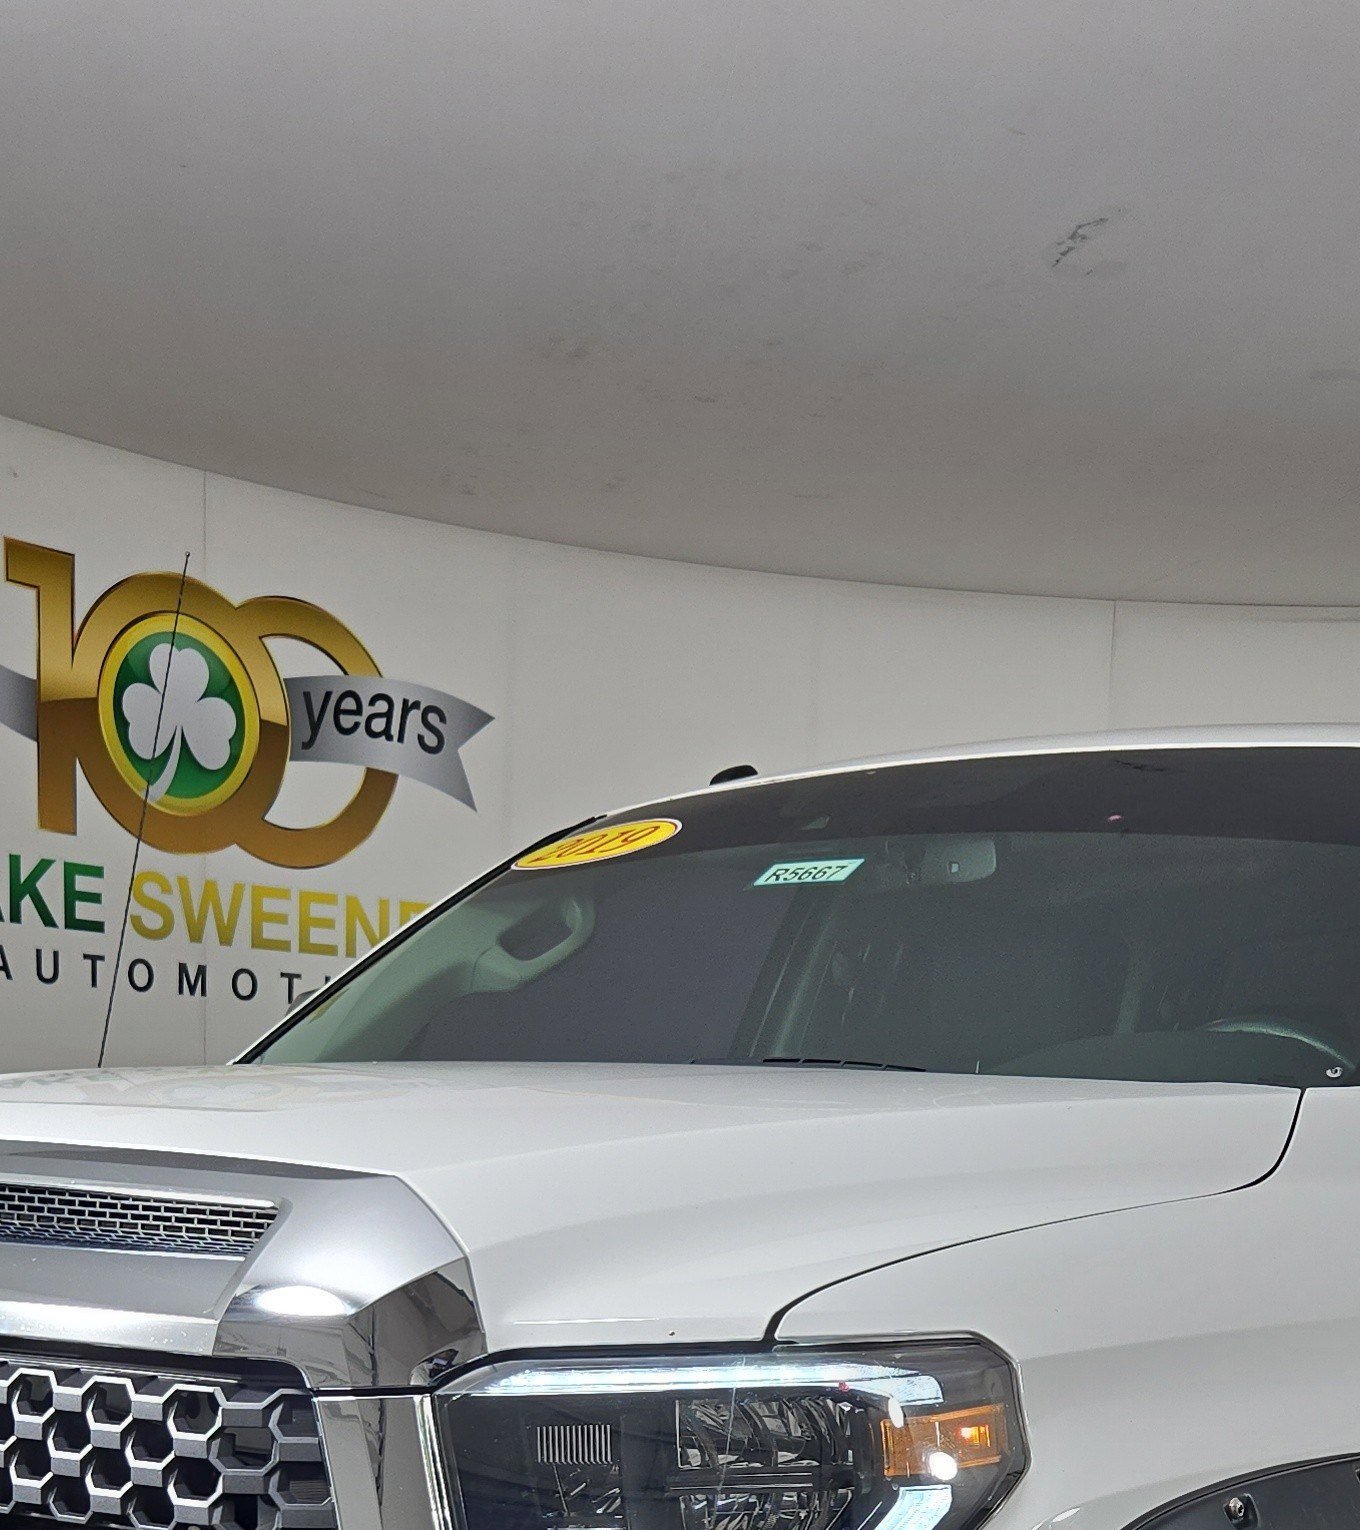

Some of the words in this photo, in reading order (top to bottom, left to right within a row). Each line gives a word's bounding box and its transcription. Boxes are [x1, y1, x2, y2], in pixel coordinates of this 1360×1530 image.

[3, 535, 398, 870] 100
[300, 687, 447, 755] years
[764, 865, 848, 882] R5667
